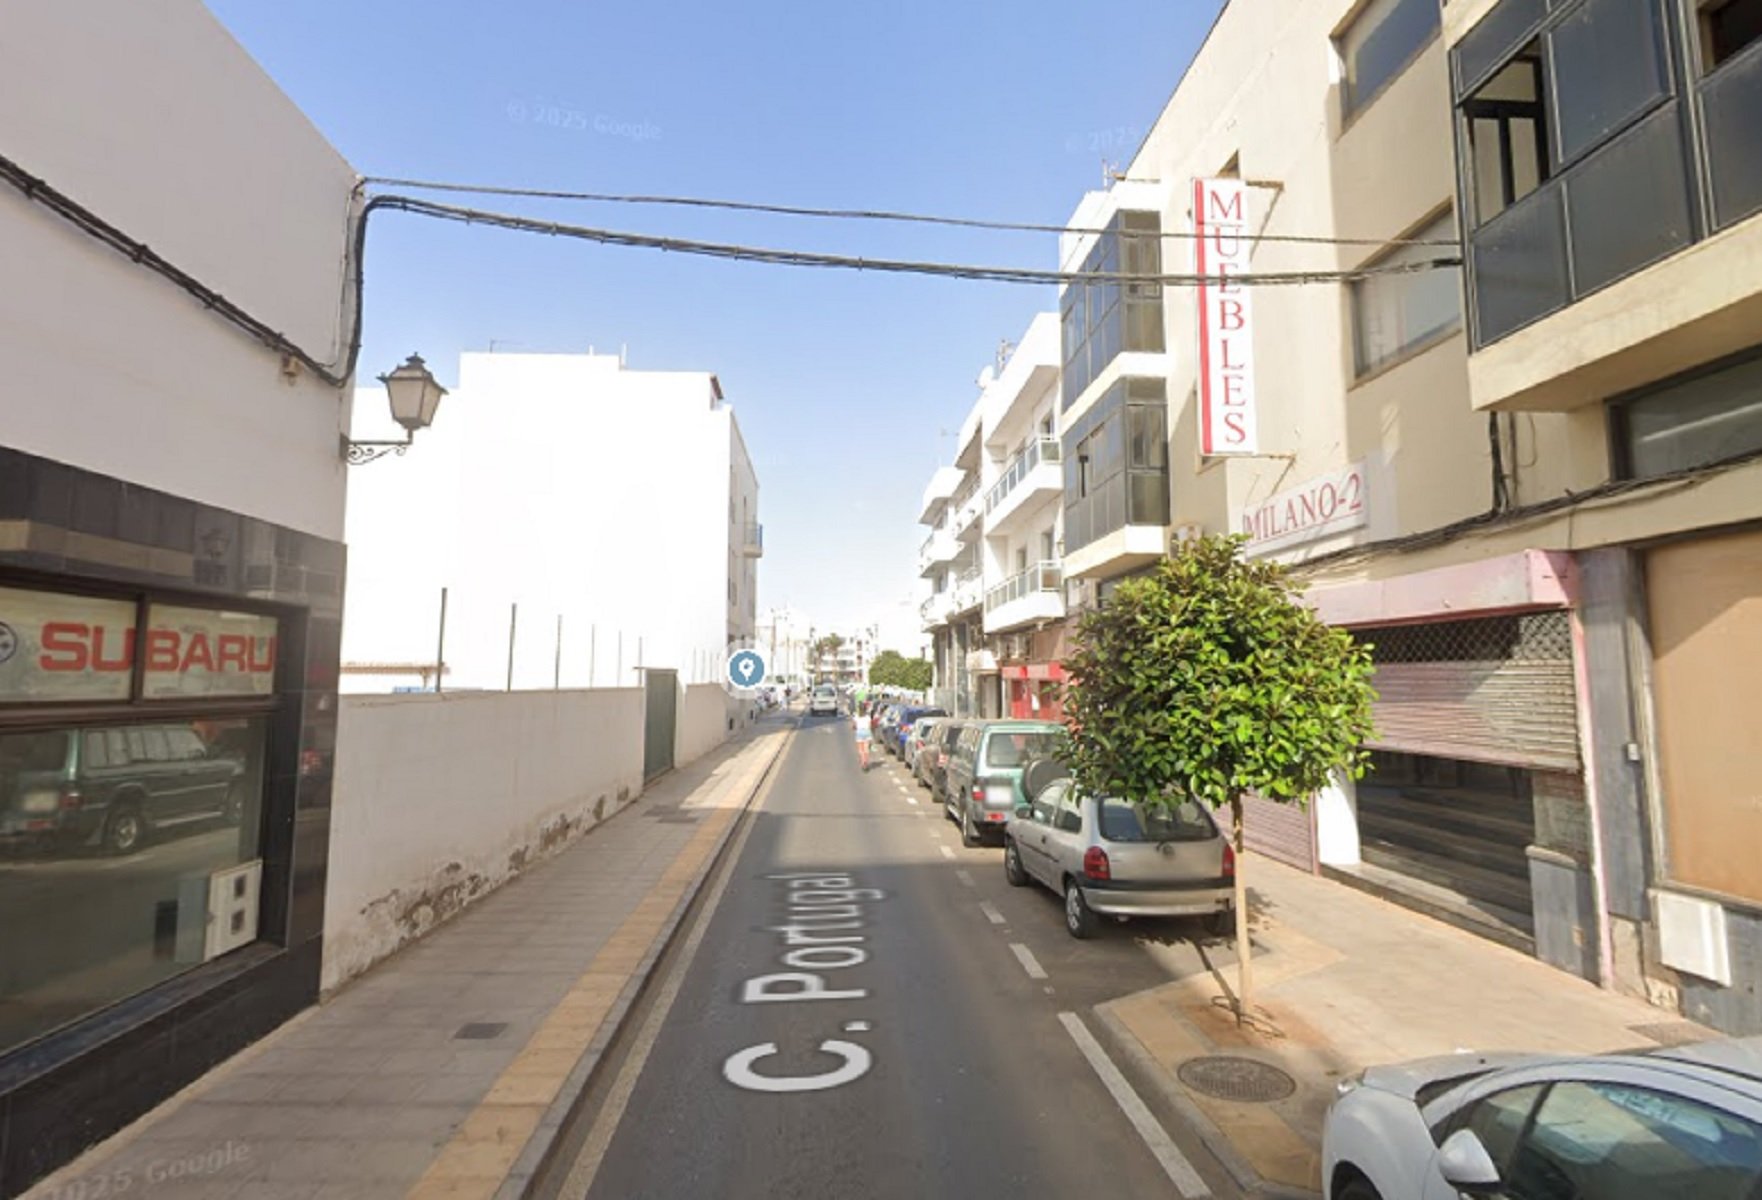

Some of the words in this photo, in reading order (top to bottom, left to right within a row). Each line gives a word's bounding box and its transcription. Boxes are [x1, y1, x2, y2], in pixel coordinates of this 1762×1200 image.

[1209, 189, 1247, 444] MUEBLES
[1242, 472, 1362, 543] MILANO-2
[39, 621, 278, 673] SUBARU
